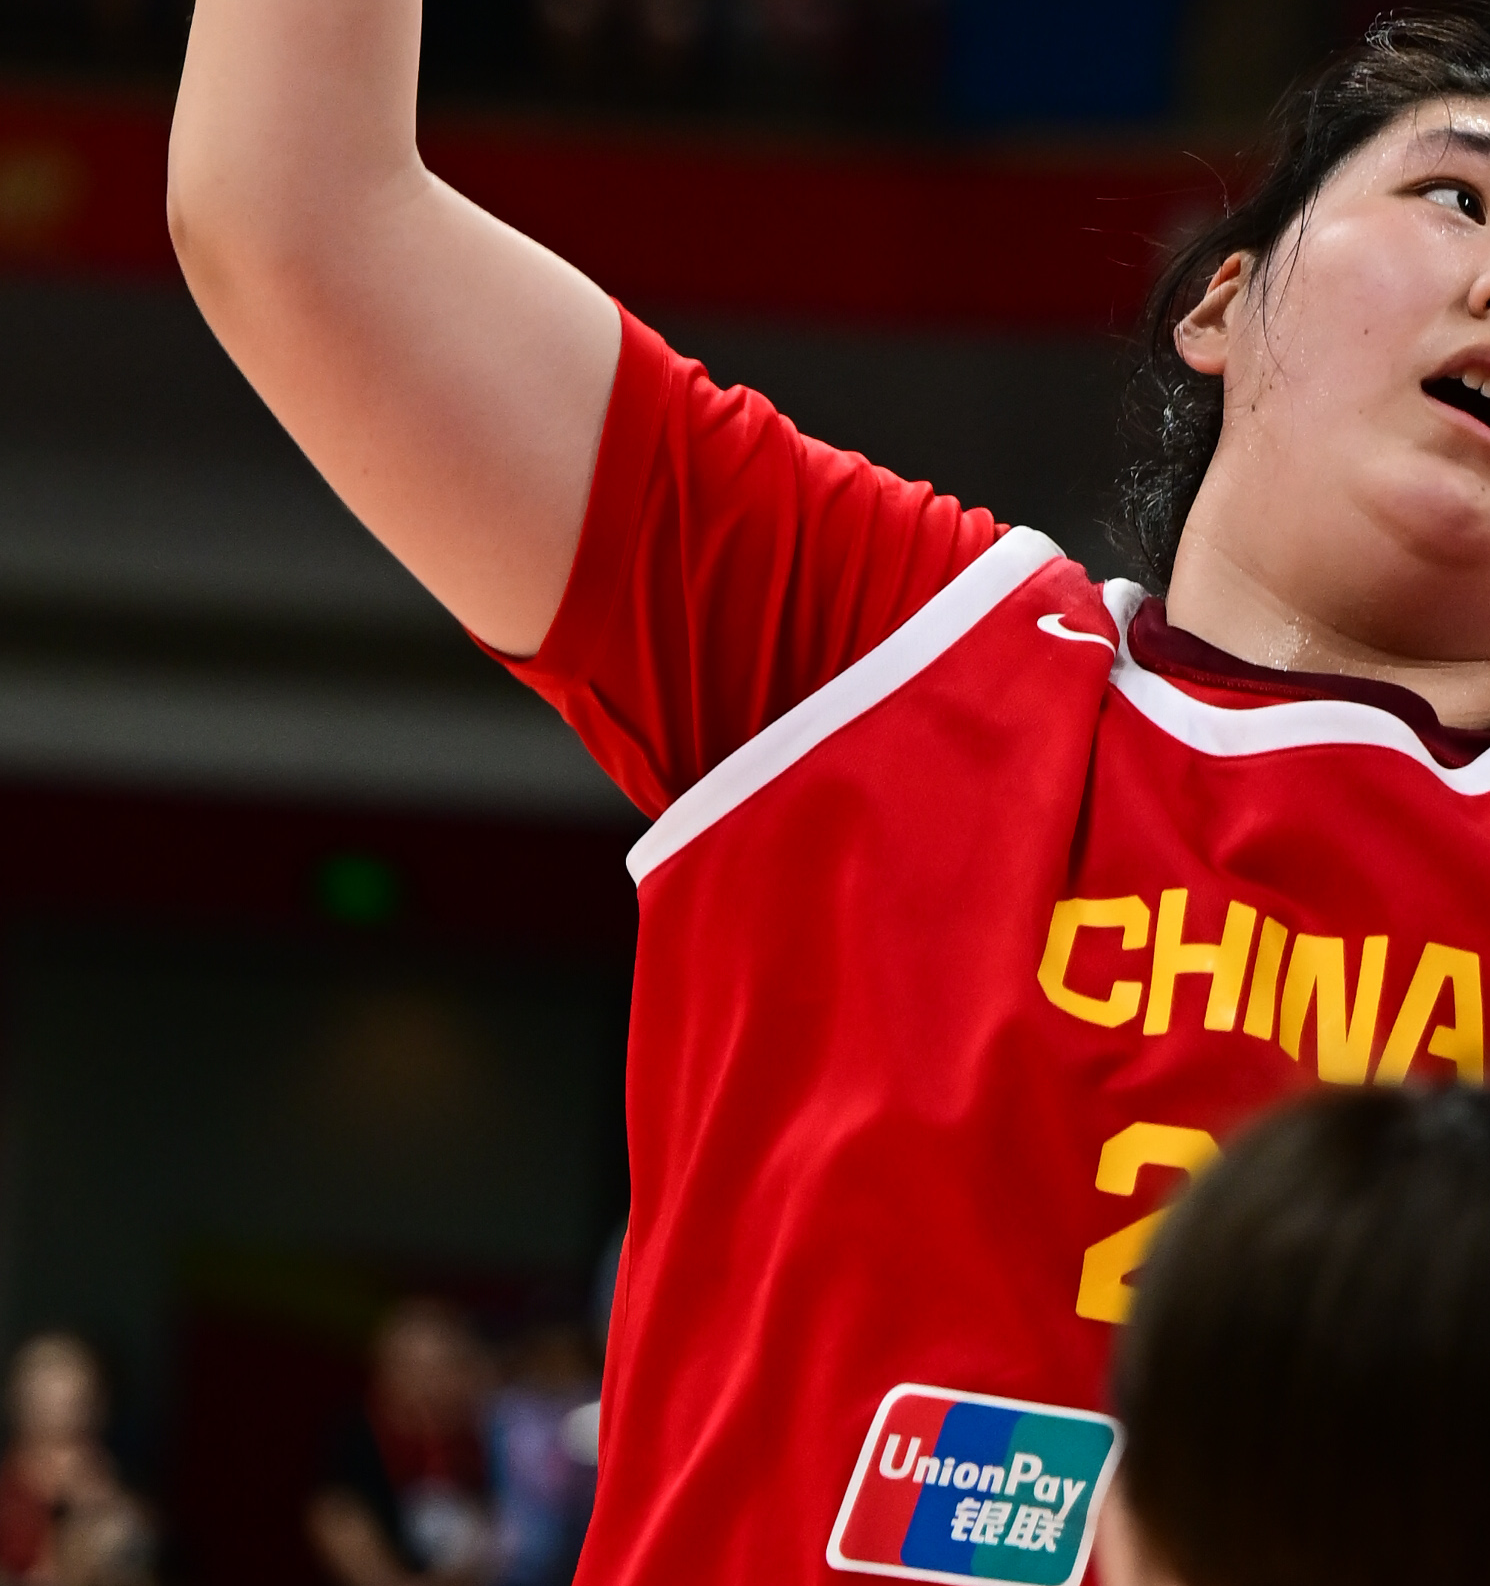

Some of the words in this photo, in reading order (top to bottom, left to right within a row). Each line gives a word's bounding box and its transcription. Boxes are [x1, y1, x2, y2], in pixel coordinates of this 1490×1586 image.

[1037, 887, 1484, 1086] CHINA
[879, 1433, 1086, 1521] UnionPay
[950, 1496, 1066, 1553] 银联
